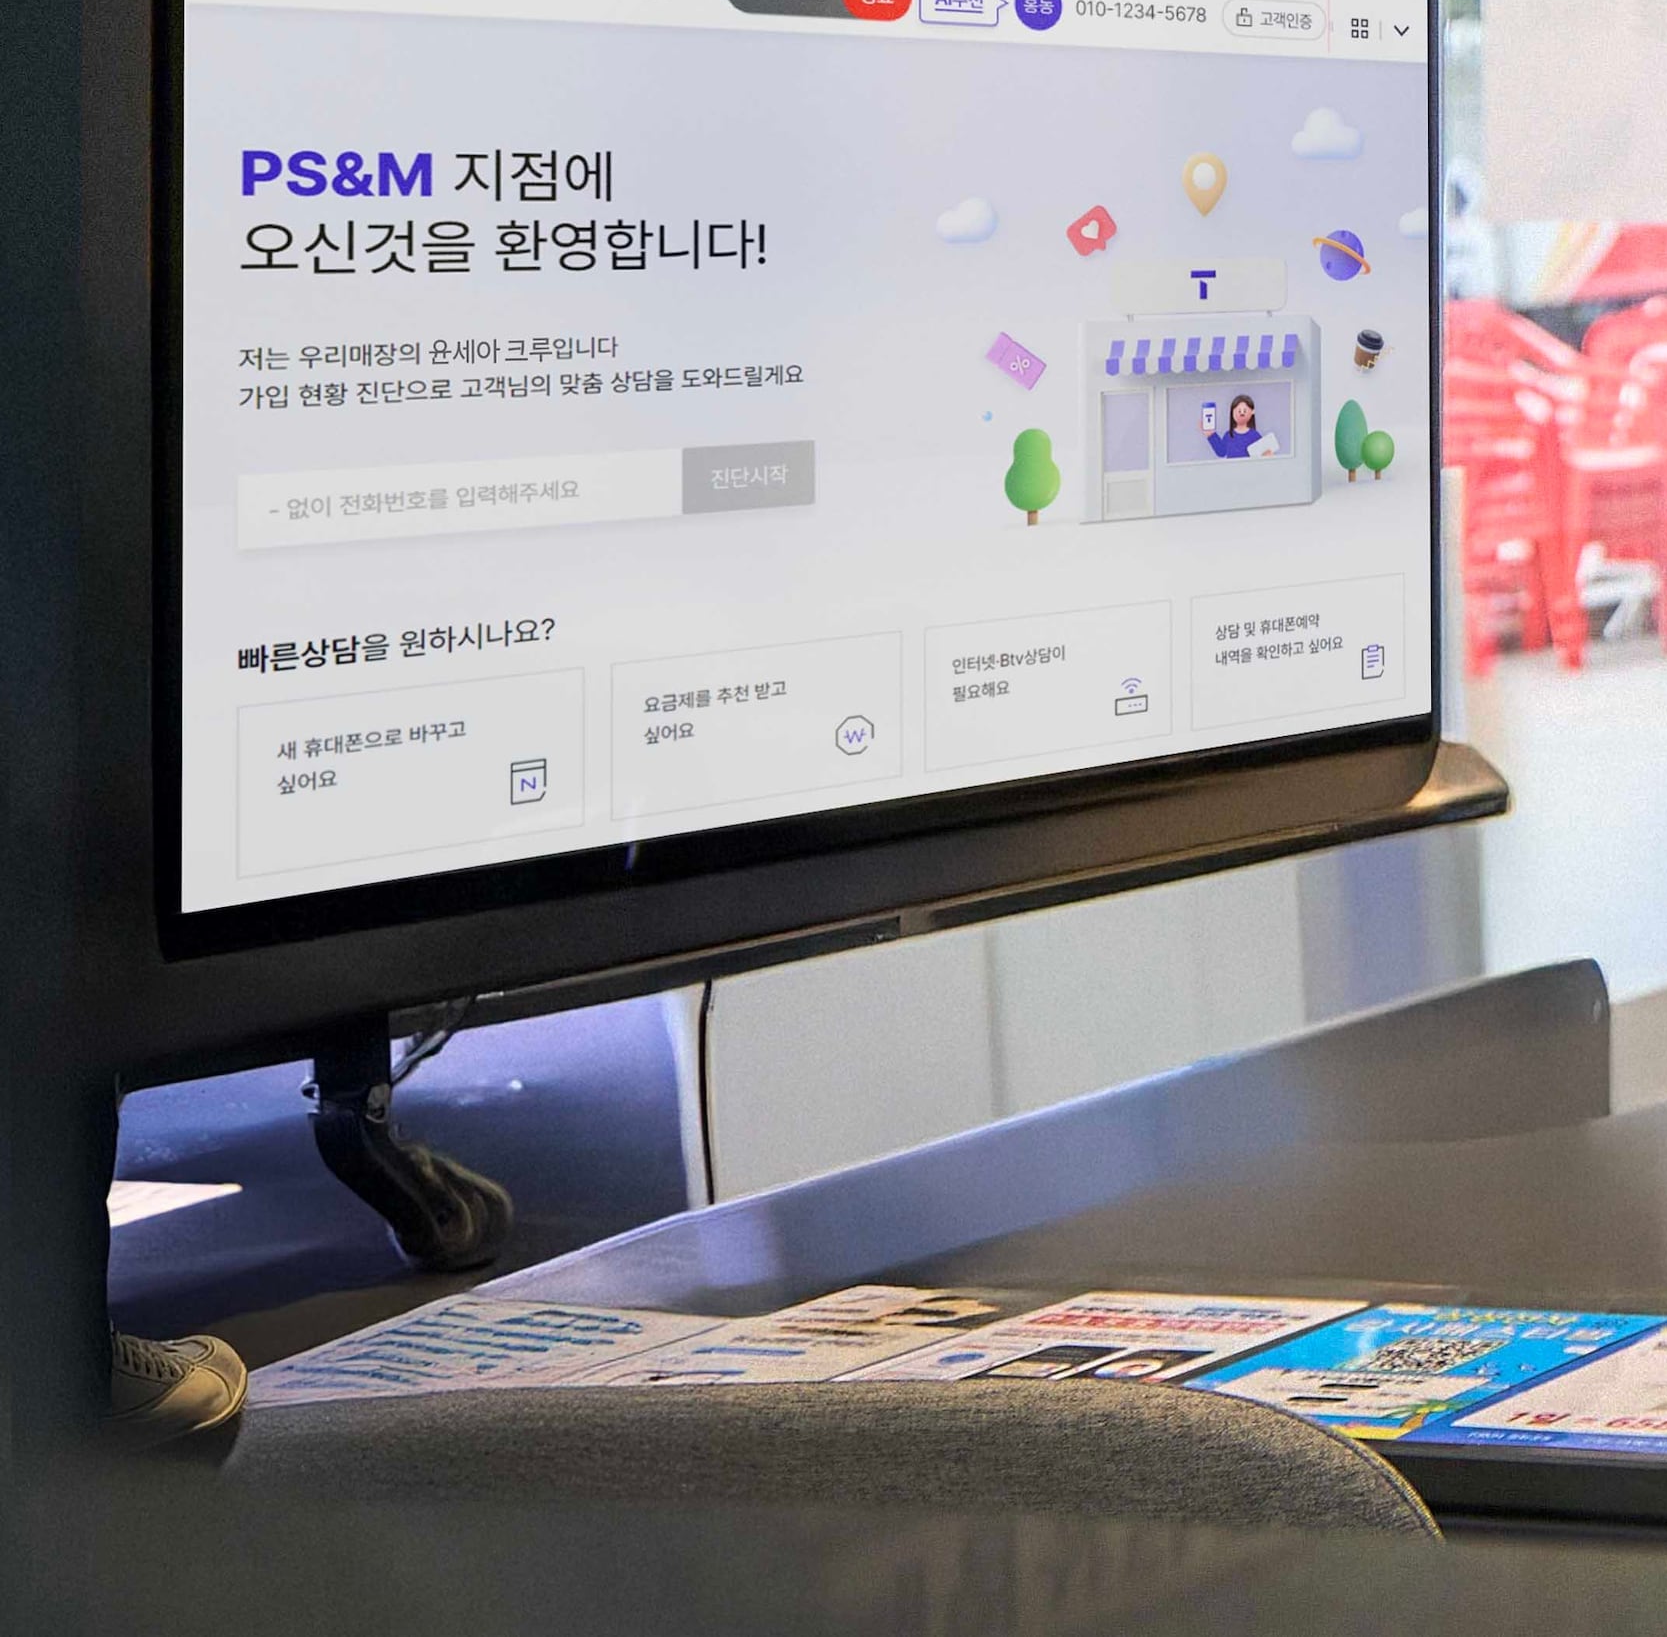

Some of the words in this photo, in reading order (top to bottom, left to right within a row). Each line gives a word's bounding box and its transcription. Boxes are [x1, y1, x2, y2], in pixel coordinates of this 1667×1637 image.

[1075, 0, 1207, 24] 010-1234-5678
[1259, 9, 1313, 31] 고객인증
[241, 149, 434, 197] PS&M
[453, 149, 614, 203] 지점에
[239, 219, 476, 275] 오신것을
[494, 219, 768, 272] 환영합니다!
[238, 345, 290, 371] 저는
[299, 340, 422, 369] 우리매장의
[428, 337, 500, 366] 윤세아
[505, 335, 619, 364] 크루입니다
[238, 381, 290, 410] 가입
[298, 381, 347, 408] 현황
[356, 377, 453, 405] 진단으로
[460, 372, 552, 401] 고객님의
[559, 370, 603, 396] 맞춤
[610, 368, 675, 394] 상담을
[681, 364, 805, 390] 도와드릴게요
[710, 464, 788, 490] 진단시작
[286, 494, 332, 521] 없이
[339, 486, 449, 516] 전화번호를
[455, 479, 580, 508] 입력해주세요
[1215, 621, 1241, 642] 상담
[1244, 619, 1256, 639] 및
[1259, 613, 1321, 637] 휴대폰예약
[237, 632, 390, 674] 빠른상담을
[399, 617, 556, 659] 원하시나요?
[1215, 644, 1252, 667] 내역을
[1255, 640, 1305, 662] 확인하고
[1307, 635, 1344, 658] 싶어요
[644, 689, 711, 715] 요금제를
[716, 683, 750, 706] 추천
[754, 680, 787, 703] 받고
[952, 680, 1010, 703] 필요해요
[277, 739, 298, 762] 새
[303, 727, 403, 760] 휴대폰으로
[409, 720, 467, 745] 바꾸고
[643, 722, 695, 746] 싶어요
[276, 769, 337, 796] 싶어요
